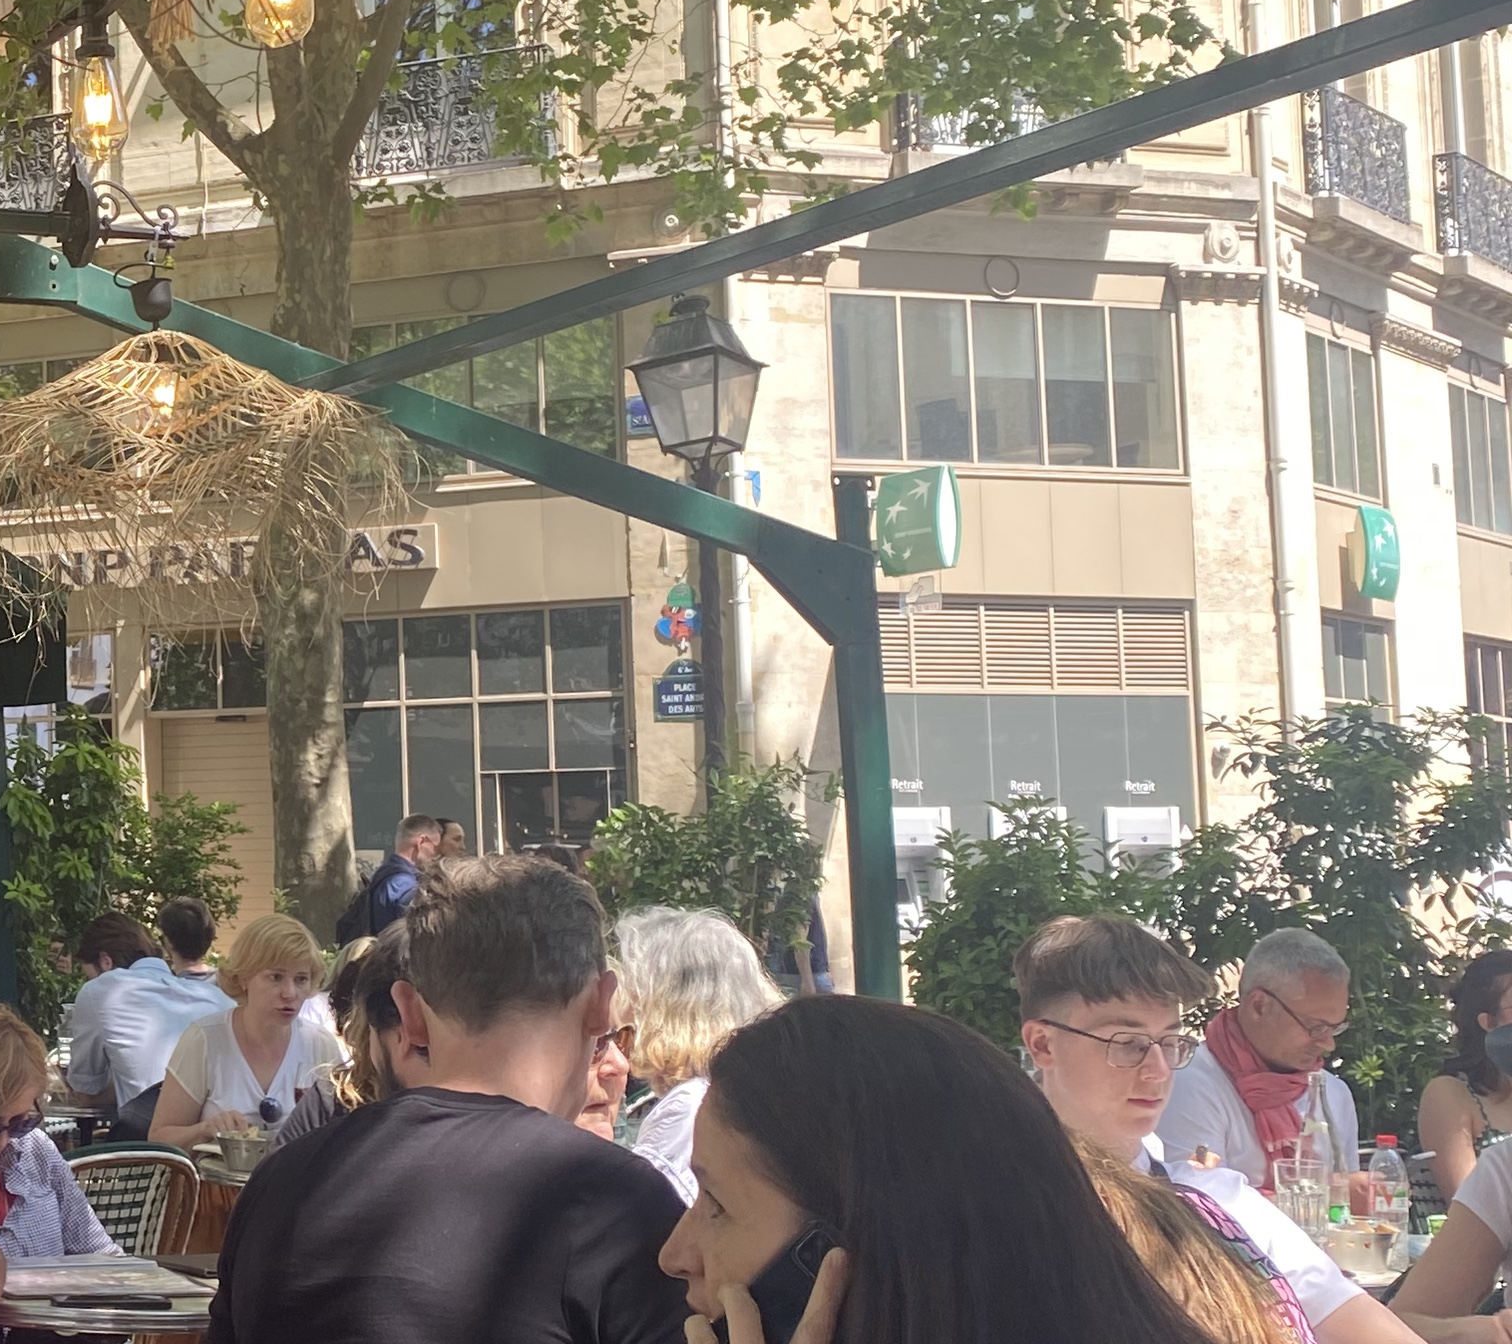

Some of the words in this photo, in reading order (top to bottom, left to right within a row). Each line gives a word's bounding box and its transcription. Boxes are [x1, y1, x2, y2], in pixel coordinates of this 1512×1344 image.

[673, 682, 696, 692] PLACE
[661, 694, 683, 703] SAINT
[668, 705, 683, 714] DES
[891, 778, 924, 790] Retrait
[1010, 780, 1042, 792] Retrait
[1125, 780, 1156, 792] Retrait
